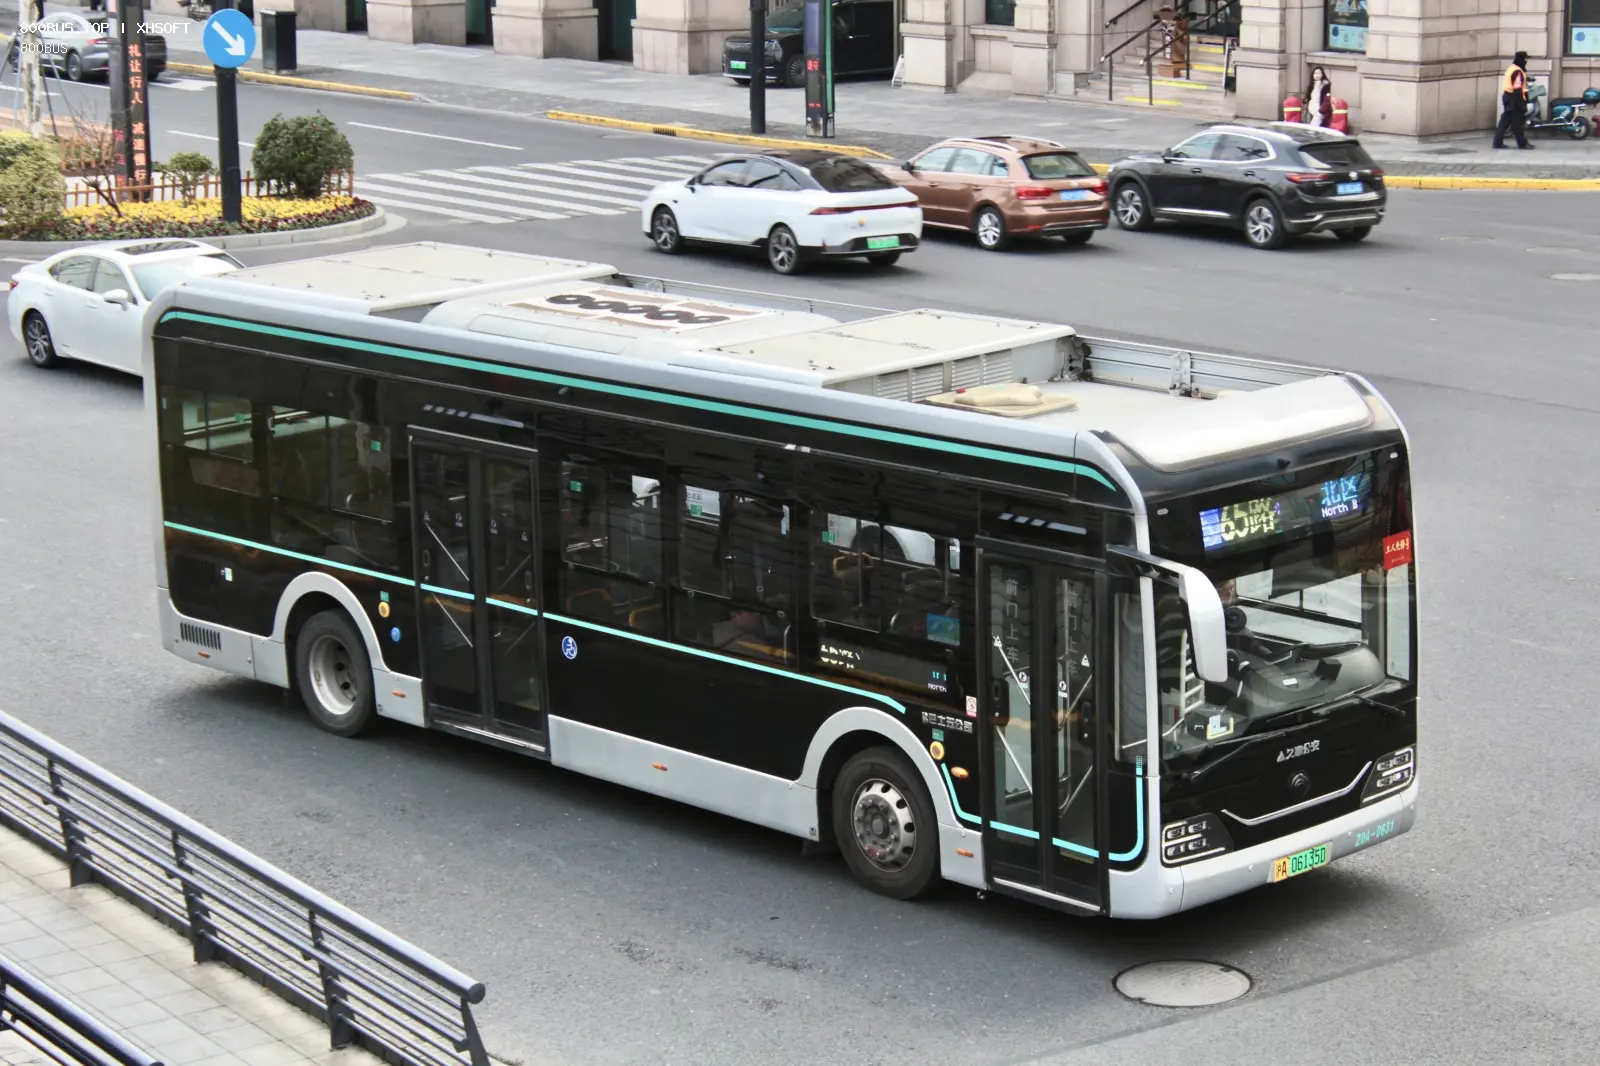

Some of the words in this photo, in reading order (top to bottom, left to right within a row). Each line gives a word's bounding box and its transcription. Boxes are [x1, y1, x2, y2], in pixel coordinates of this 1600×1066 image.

[128, 44, 144, 104] 礼让行人
[1321, 503, 1349, 518] North
